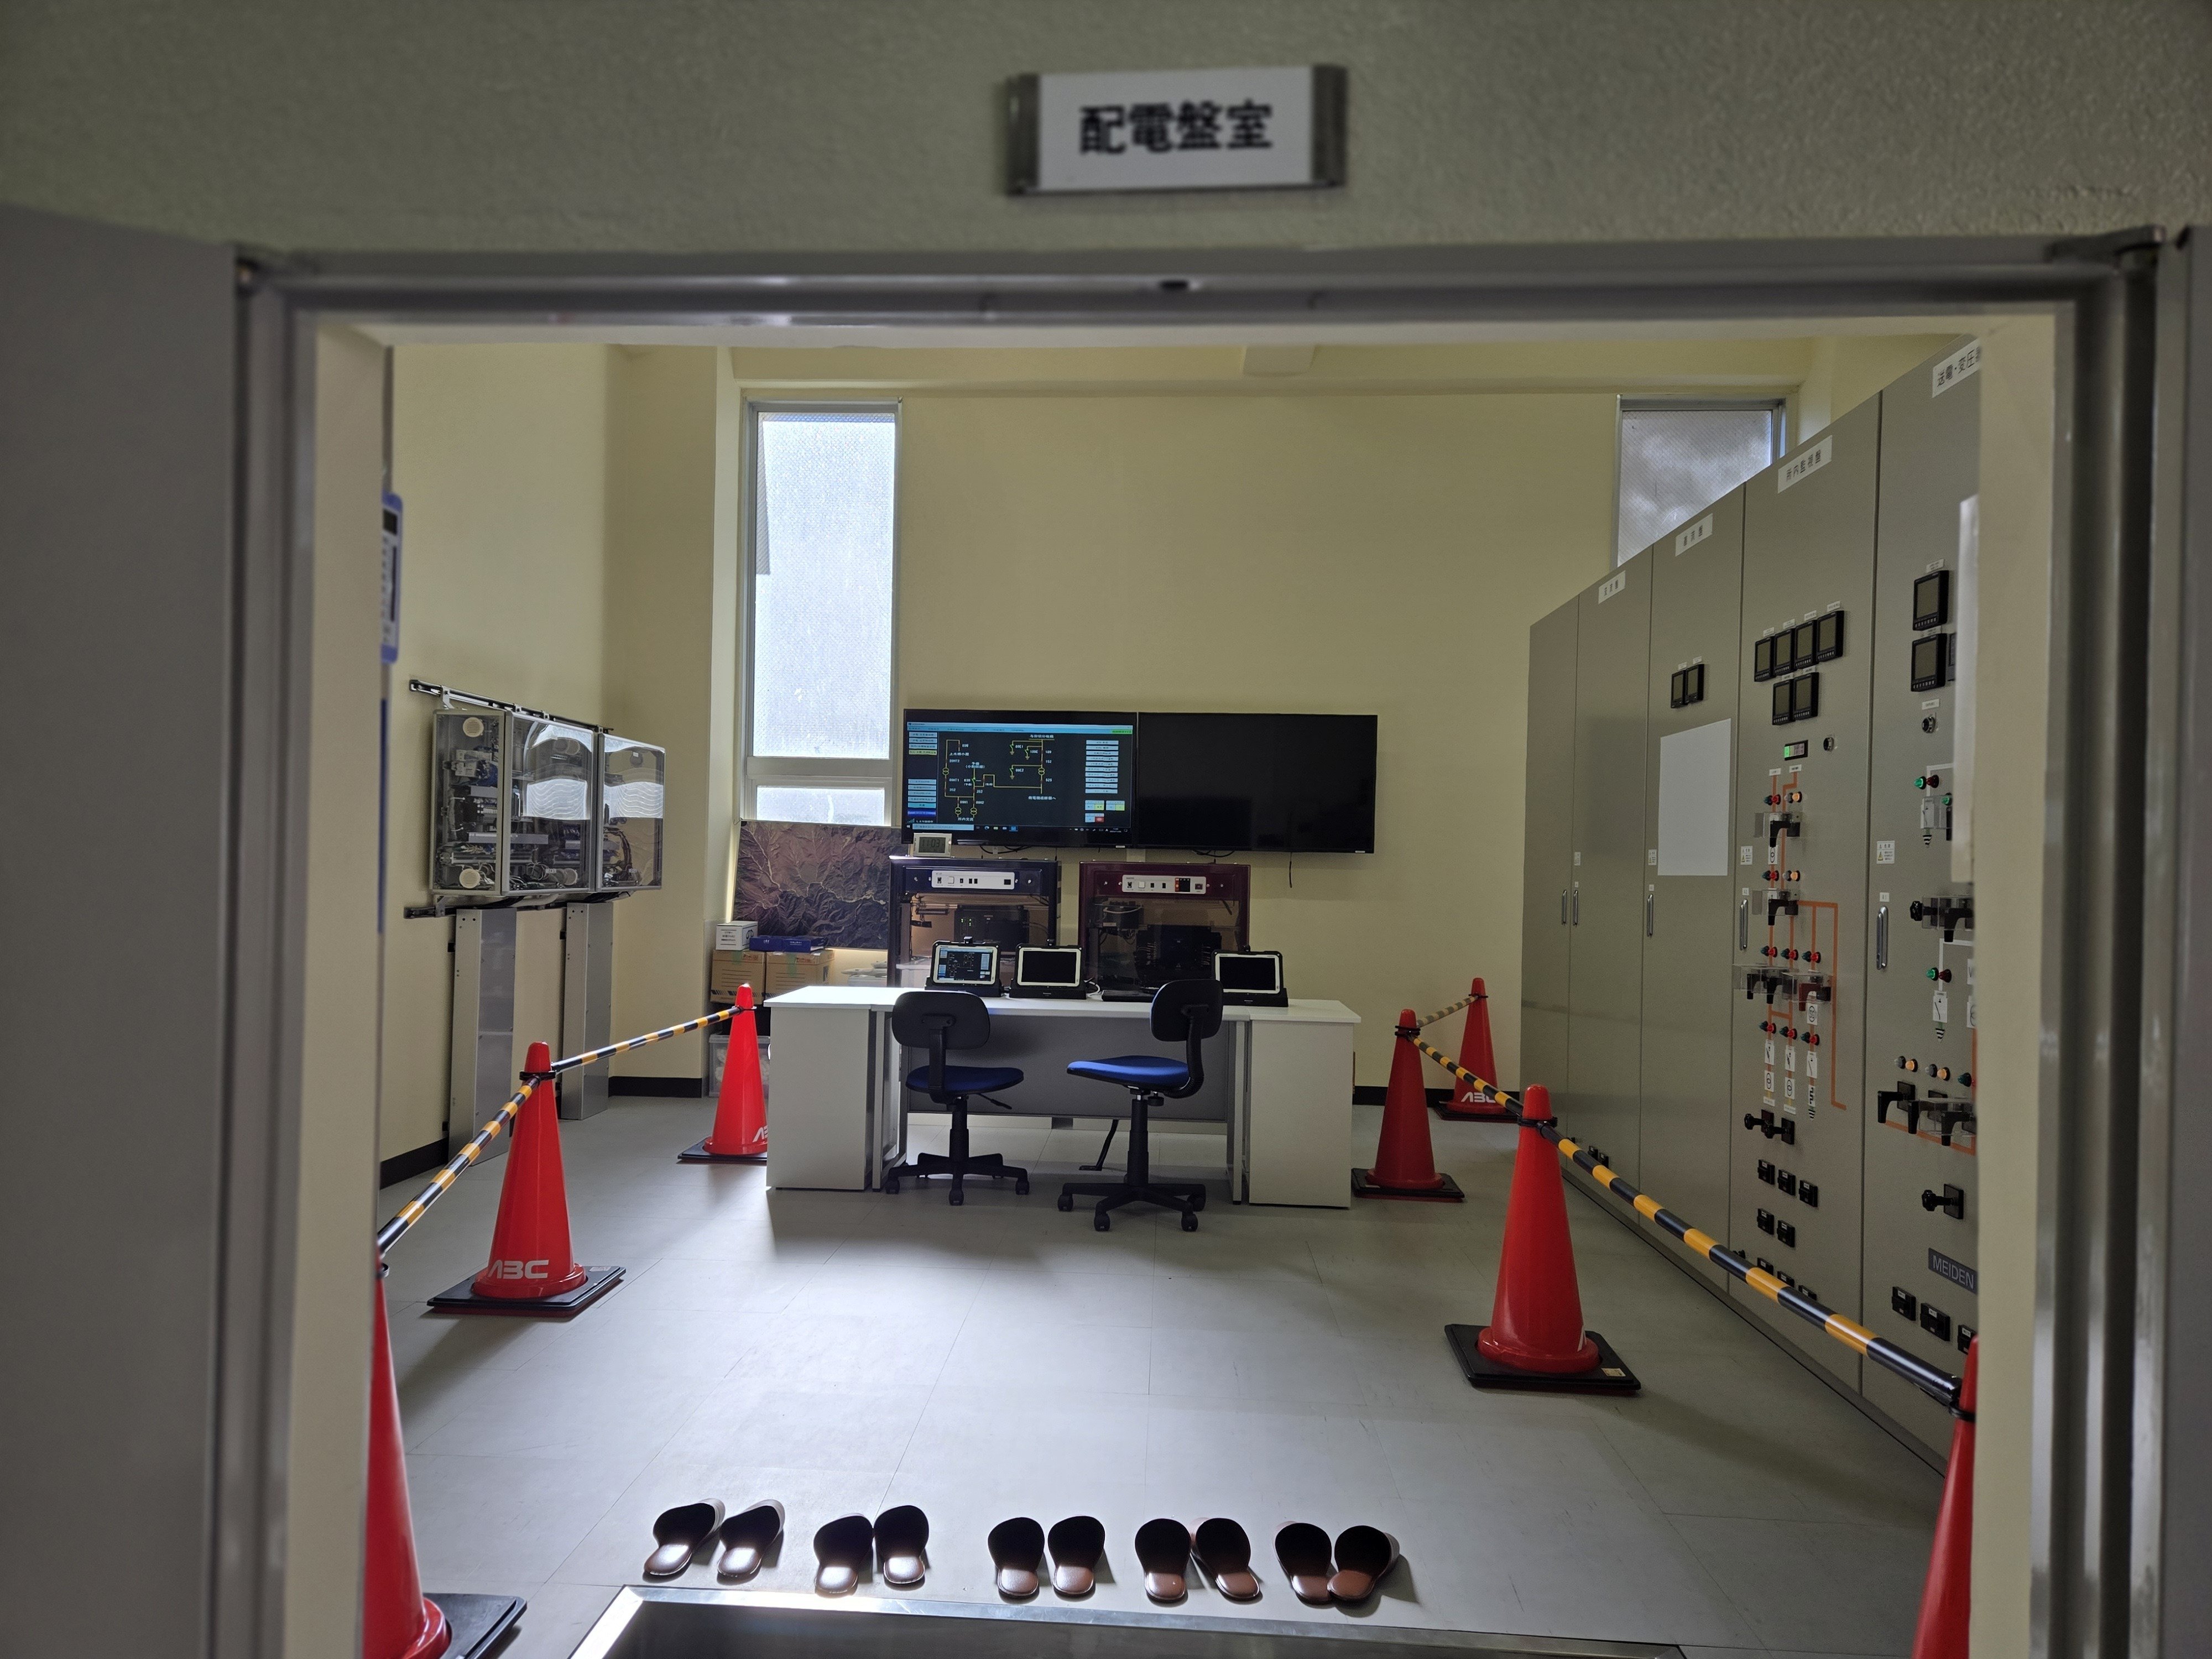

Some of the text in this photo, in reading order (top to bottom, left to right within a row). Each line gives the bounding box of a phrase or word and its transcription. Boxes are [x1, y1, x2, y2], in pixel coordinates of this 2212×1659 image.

[1078, 98, 1272, 155] 配電盤室
[487, 1259, 549, 1280] ABC
[1933, 1254, 1974, 1290] MEIDEN
